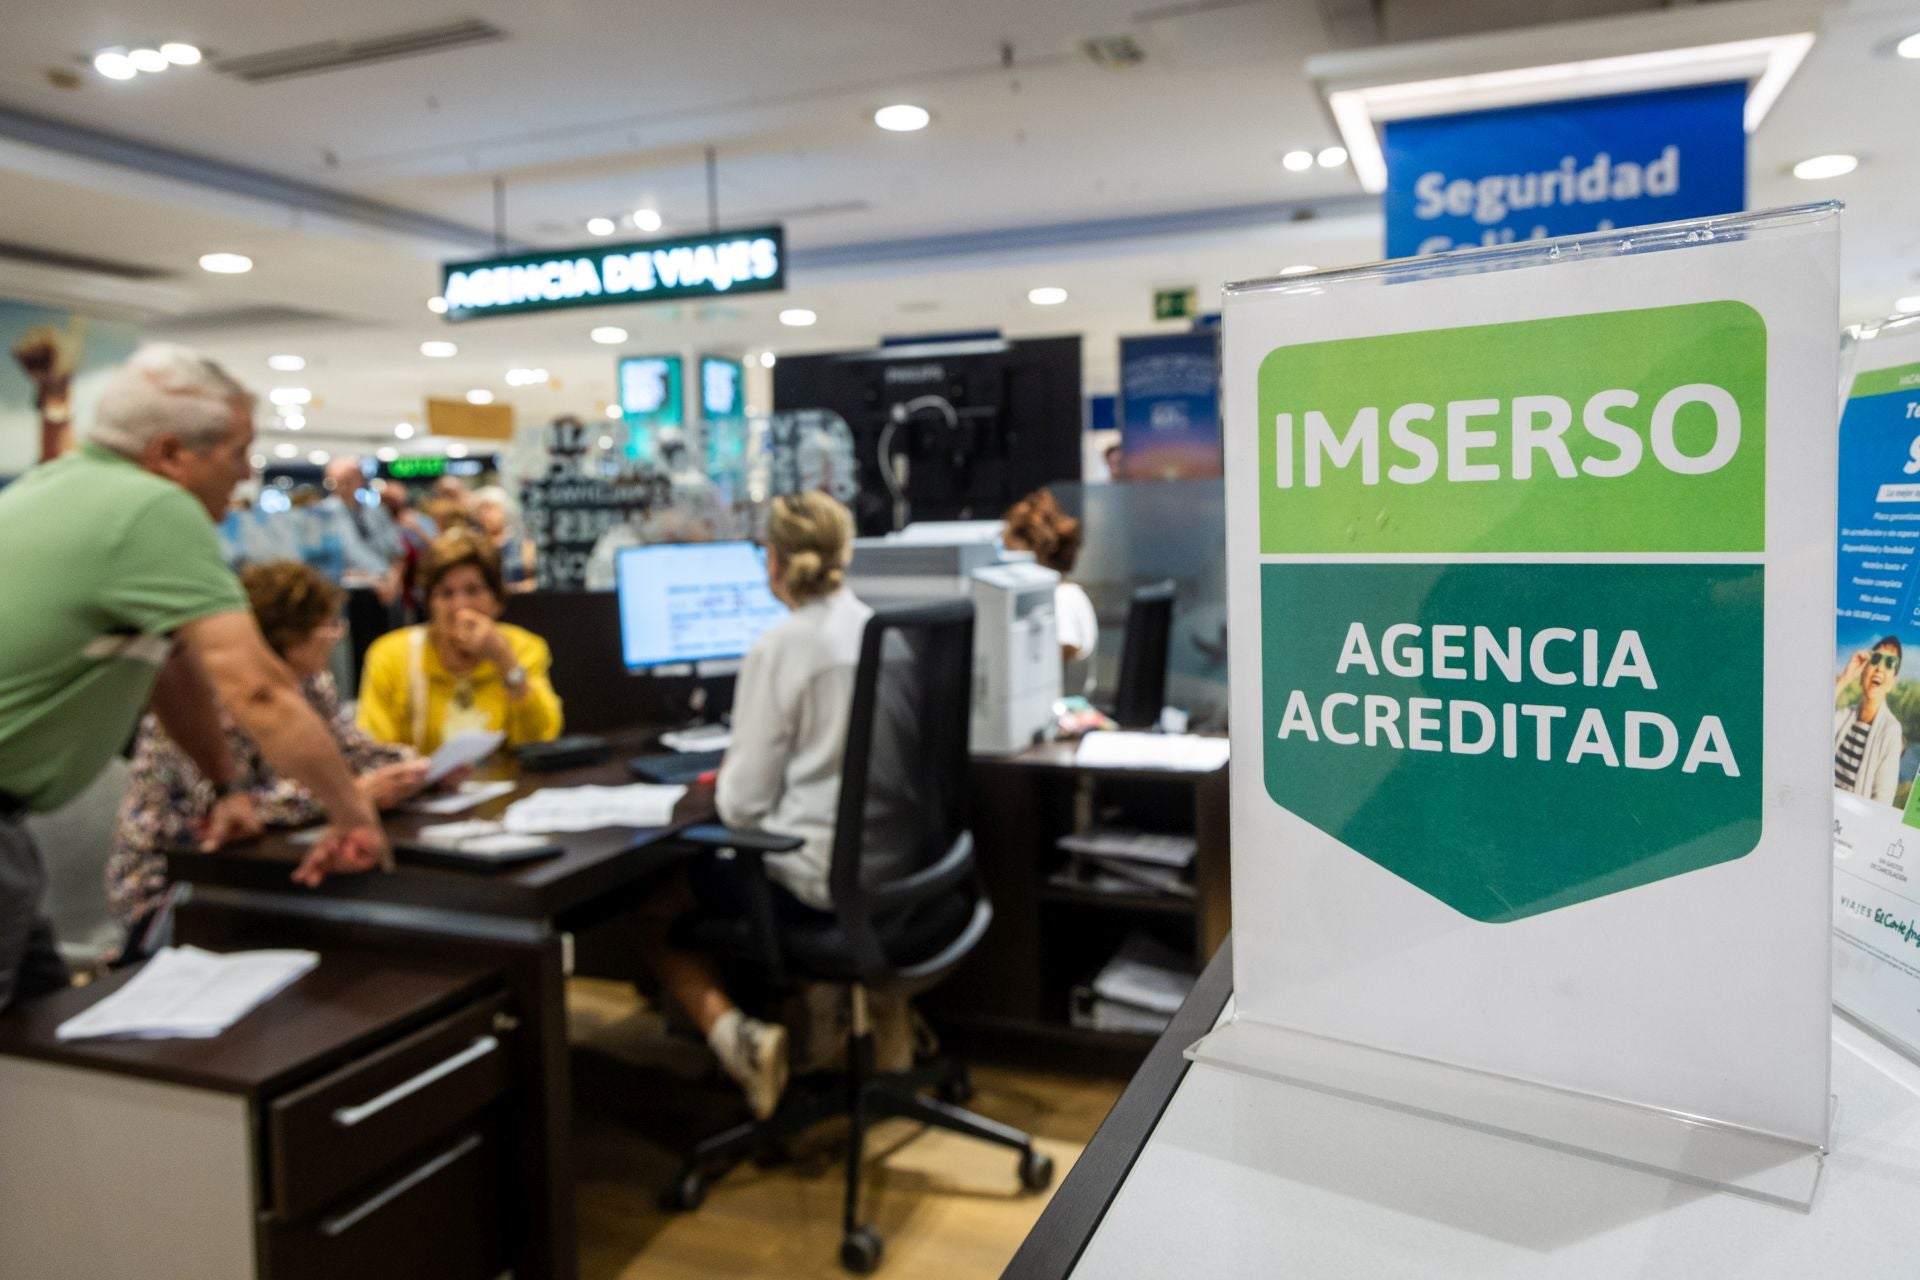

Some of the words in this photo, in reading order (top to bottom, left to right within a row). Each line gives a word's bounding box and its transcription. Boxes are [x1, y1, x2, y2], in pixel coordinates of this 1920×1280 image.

[1414, 145, 1681, 224] Seguridad
[444, 257, 602, 309] AGENCIA
[602, 253, 656, 294] DE
[654, 238, 778, 291] VIAJES
[1276, 383, 1742, 489] IMSERSO
[1336, 622, 1658, 690] AGENCIA
[1277, 690, 1741, 777] ACREDITADA
[1840, 895, 1872, 918] VIAJES
